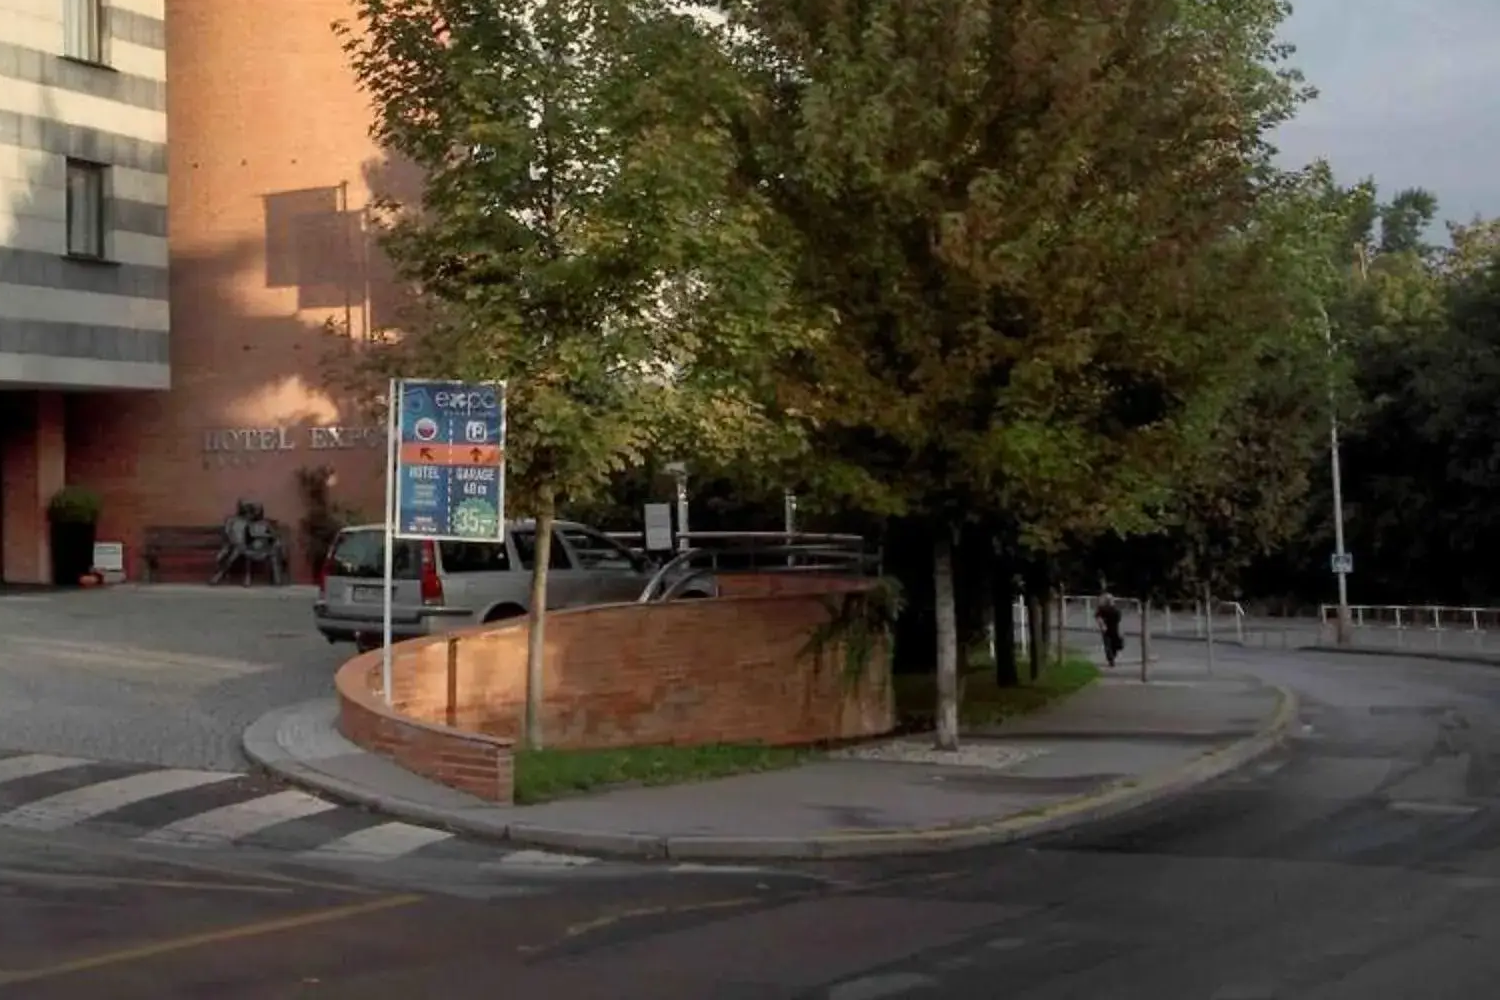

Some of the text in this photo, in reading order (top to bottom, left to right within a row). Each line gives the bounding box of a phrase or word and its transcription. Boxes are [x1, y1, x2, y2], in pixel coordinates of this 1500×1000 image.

[434, 390, 496, 416] expo
[204, 427, 295, 450] HOTEL
[455, 467, 494, 481] GARAGE
